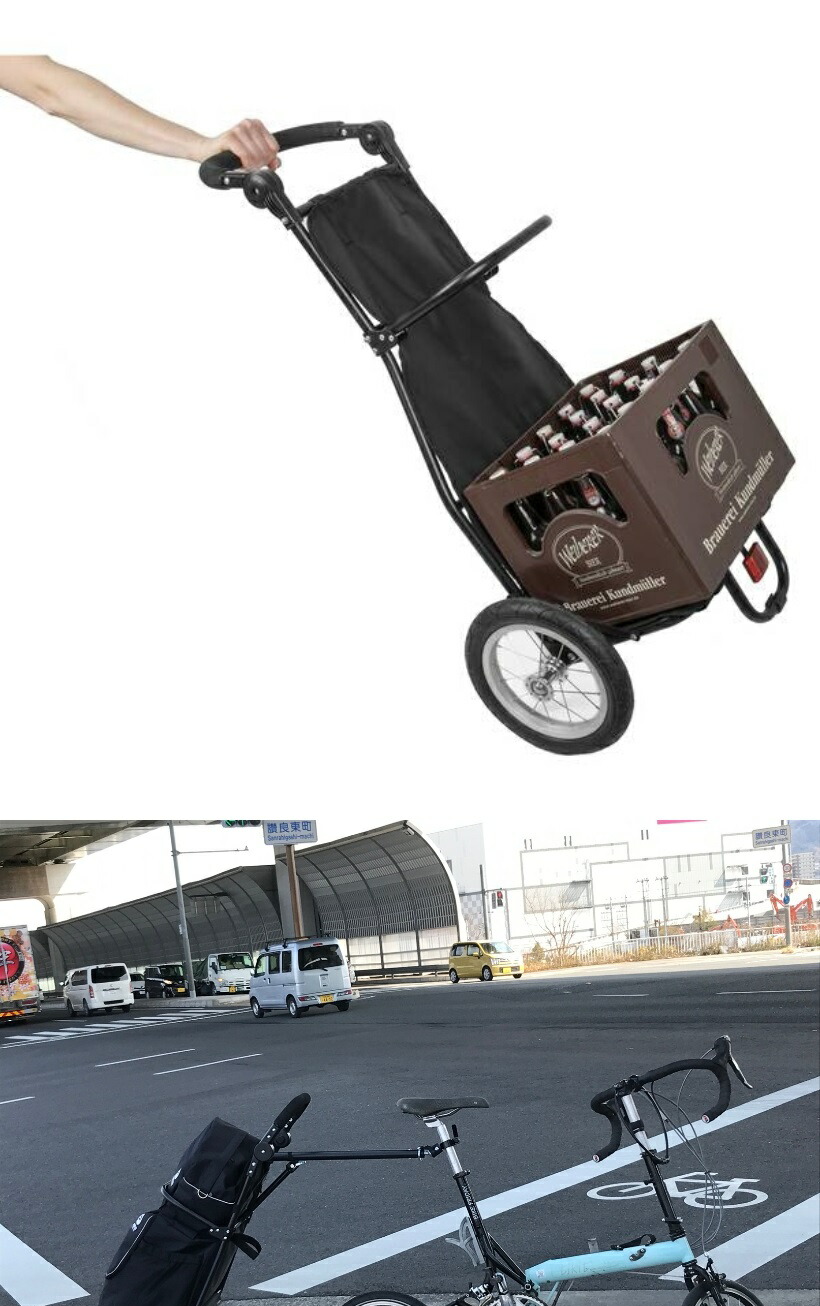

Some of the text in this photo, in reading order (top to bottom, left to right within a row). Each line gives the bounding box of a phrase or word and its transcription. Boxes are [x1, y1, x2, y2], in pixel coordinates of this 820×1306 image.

[702, 502, 739, 555] Brauerei
[734, 450, 775, 509] Kundmüller
[605, 576, 667, 601] Kundmüller
